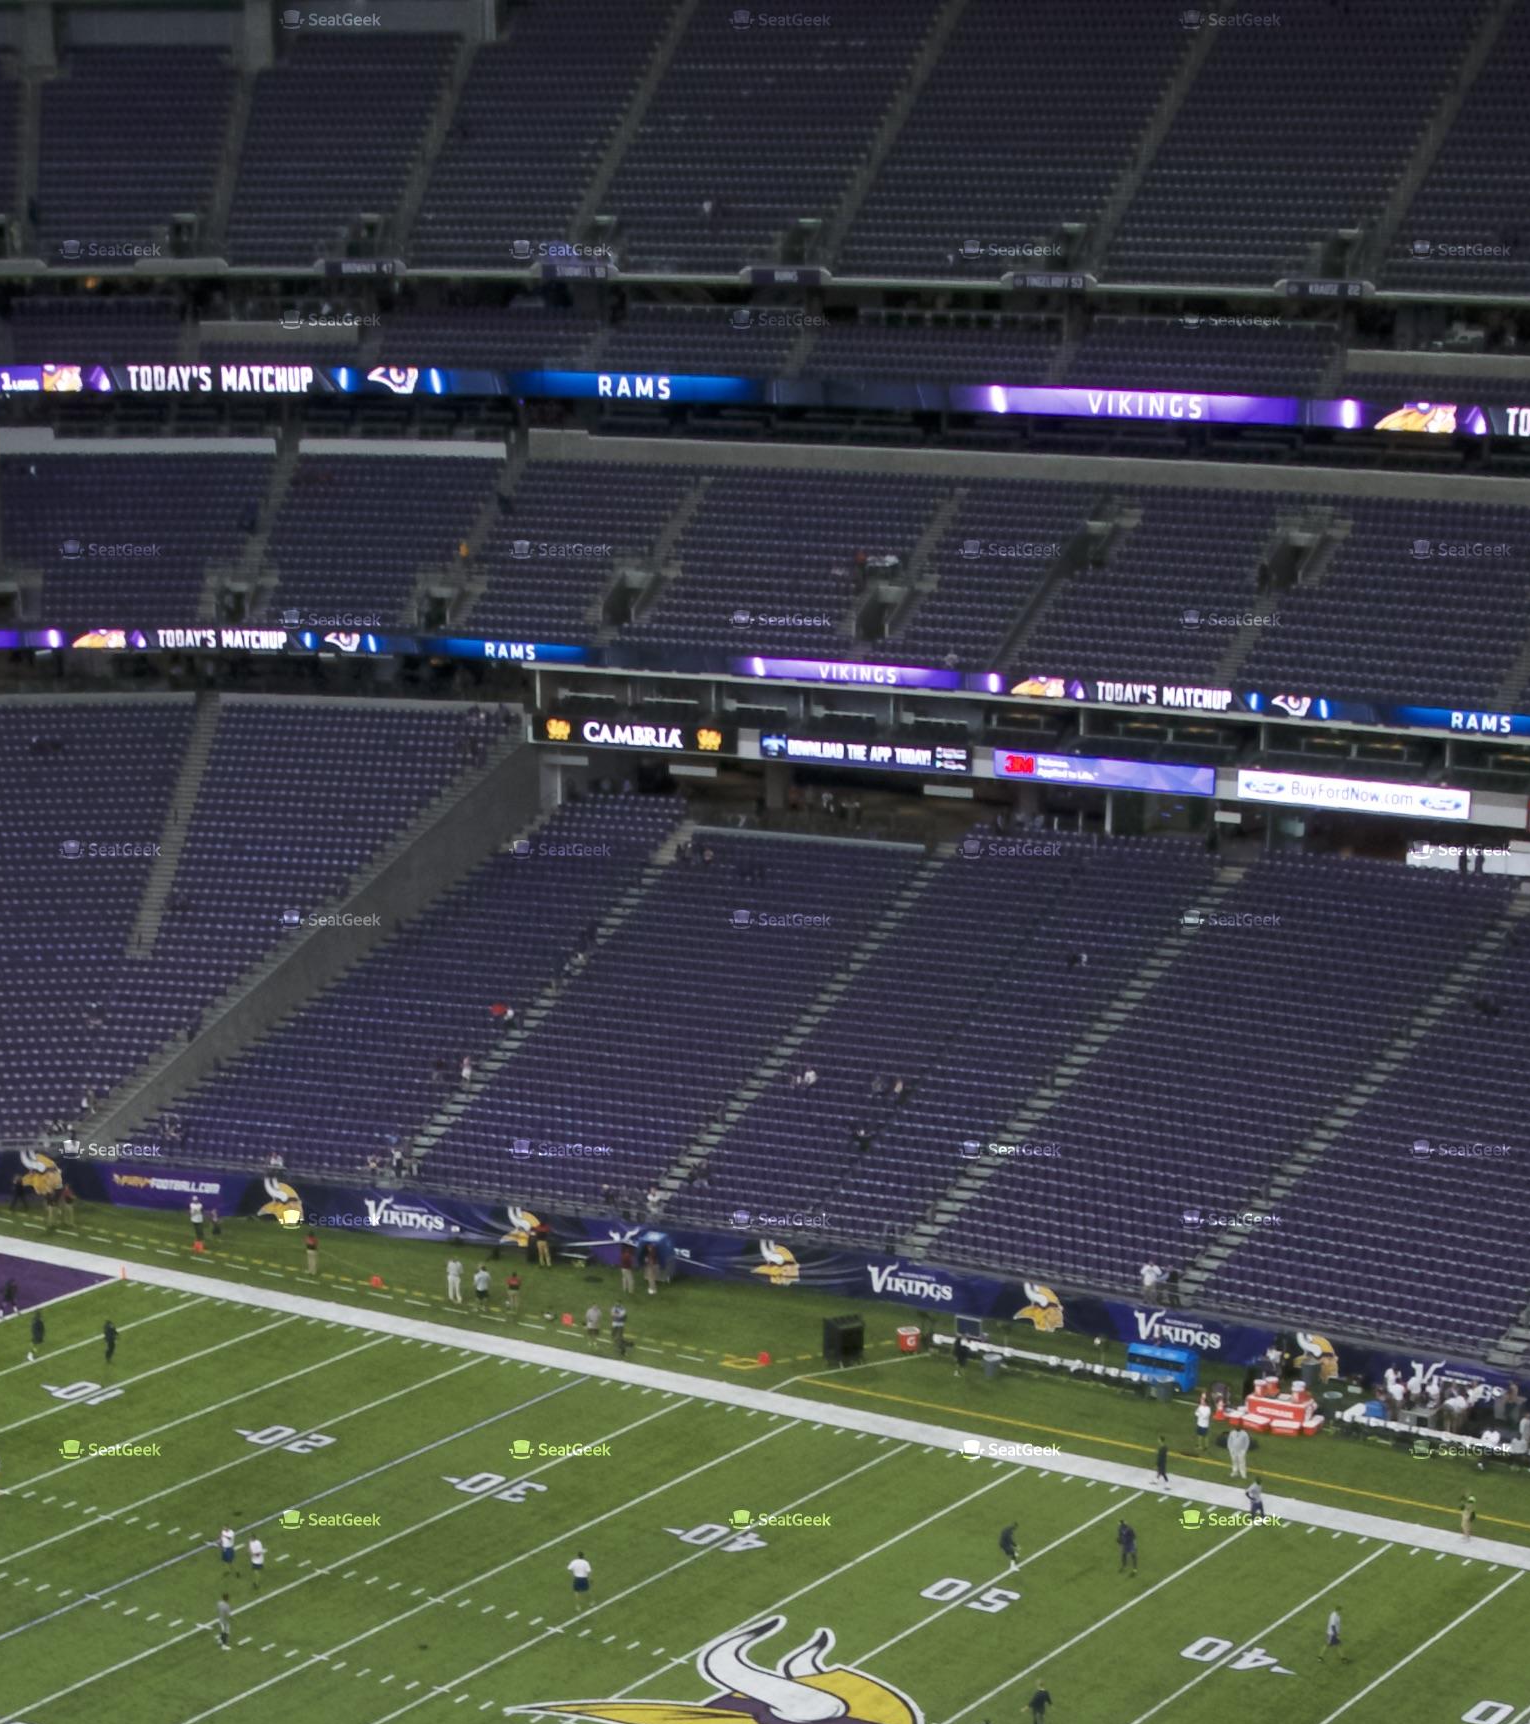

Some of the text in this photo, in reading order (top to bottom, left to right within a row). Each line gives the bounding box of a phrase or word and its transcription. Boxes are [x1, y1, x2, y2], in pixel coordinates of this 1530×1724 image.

[127, 365, 314, 393] TODAY'S MATCHUP
[597, 375, 671, 400] RAMS
[1088, 392, 1203, 419] VIKINGS
[157, 628, 287, 649] TODAY'S MATCHUP
[484, 642, 536, 660] RAMS
[819, 665, 898, 684] VIKINGS
[1096, 681, 1232, 711] TODAY'S MATCHUP
[582, 721, 684, 749] CAMBRIA
[1450, 711, 1511, 733] RAMS
[787, 739, 845, 759] DOWNLOAD
[847, 744, 868, 761] THE
[870, 745, 892, 763] APP
[894, 746, 932, 766] TODAY!
[1004, 754, 1035, 774] 3M
[1291, 781, 1413, 806] BuyFordNow.com
[363, 1195, 445, 1233] VIKINGS
[866, 1260, 953, 1301] VIKINGS
[1133, 1309, 1221, 1350] VIKINGS
[50, 1380, 125, 1405] 10
[245, 1424, 337, 1454] 20
[454, 1472, 548, 1503] 30
[678, 1523, 768, 1552] 40
[919, 1576, 1021, 1613] 50
[1179, 1636, 1279, 1670] 40
